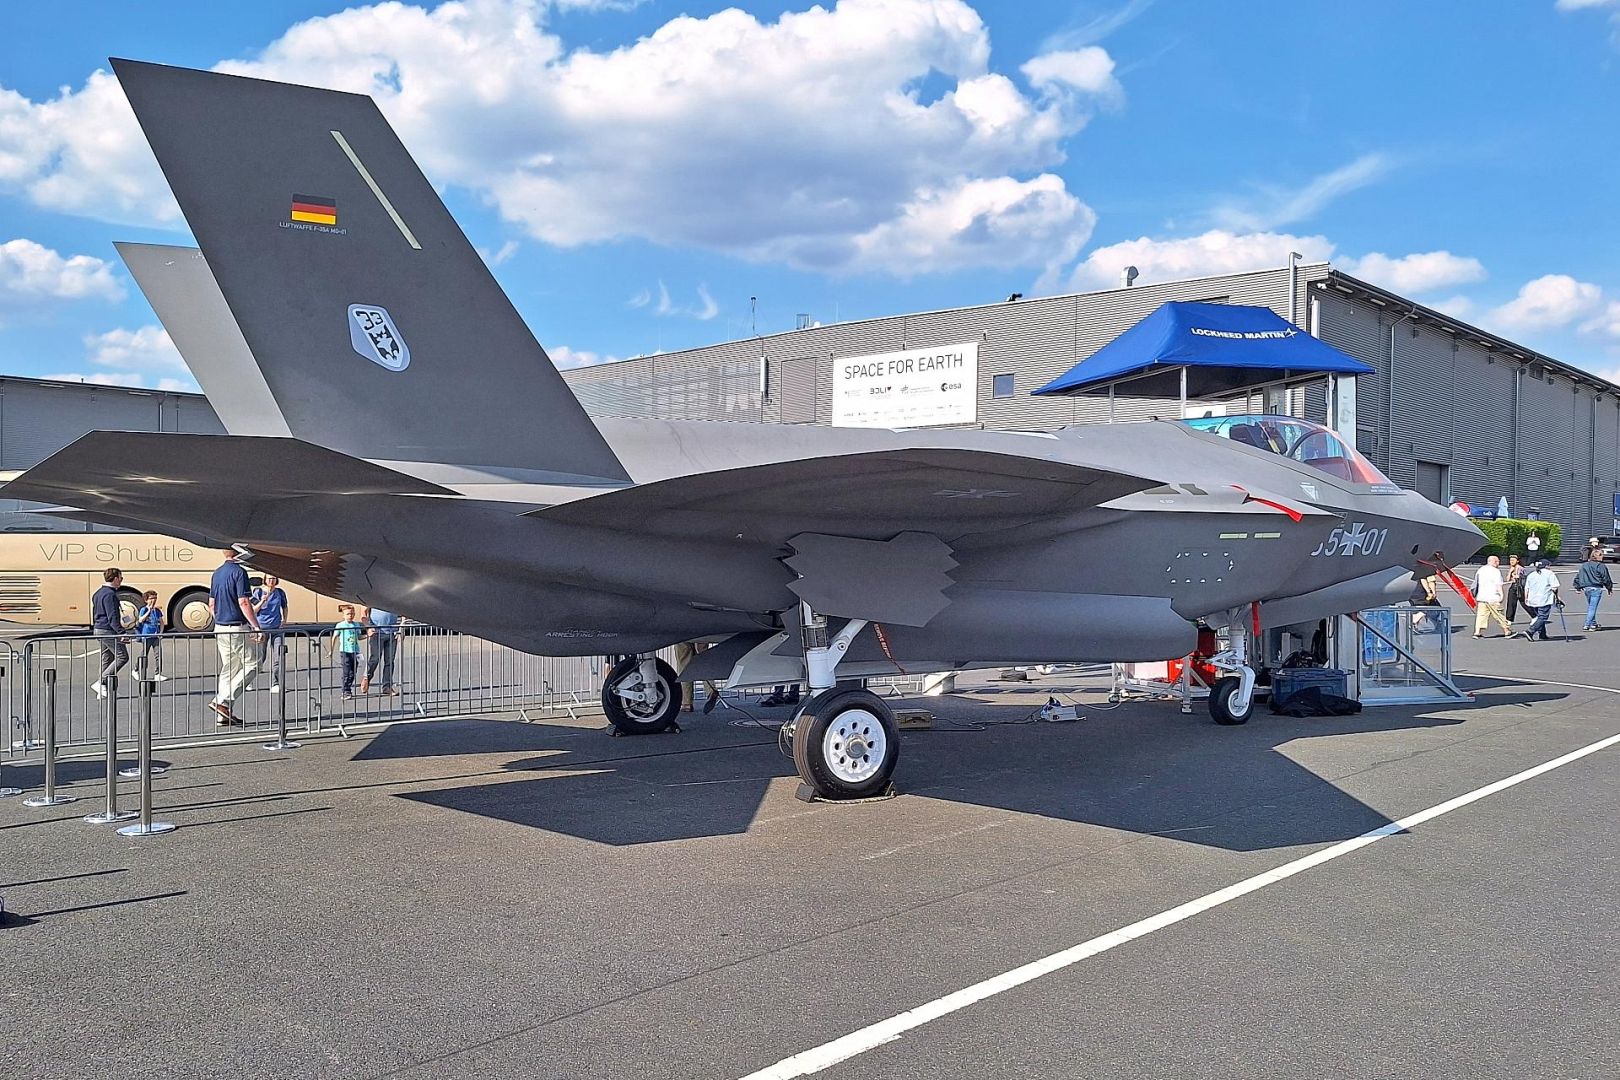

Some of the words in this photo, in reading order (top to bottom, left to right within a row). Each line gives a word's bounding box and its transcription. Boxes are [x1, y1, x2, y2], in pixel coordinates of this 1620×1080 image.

[355, 310, 384, 331] 33
[1190, 327, 1242, 339] LOCKHEED
[1244, 330, 1286, 339] MARTIN
[844, 361, 884, 380] SPACE
[888, 358, 914, 375] FOR
[918, 352, 963, 372] EARTH
[948, 382, 962, 390] esa
[1361, 528, 1388, 556] 01
[39, 543, 85, 561] VIP
[95, 543, 194, 562] Shuttle
